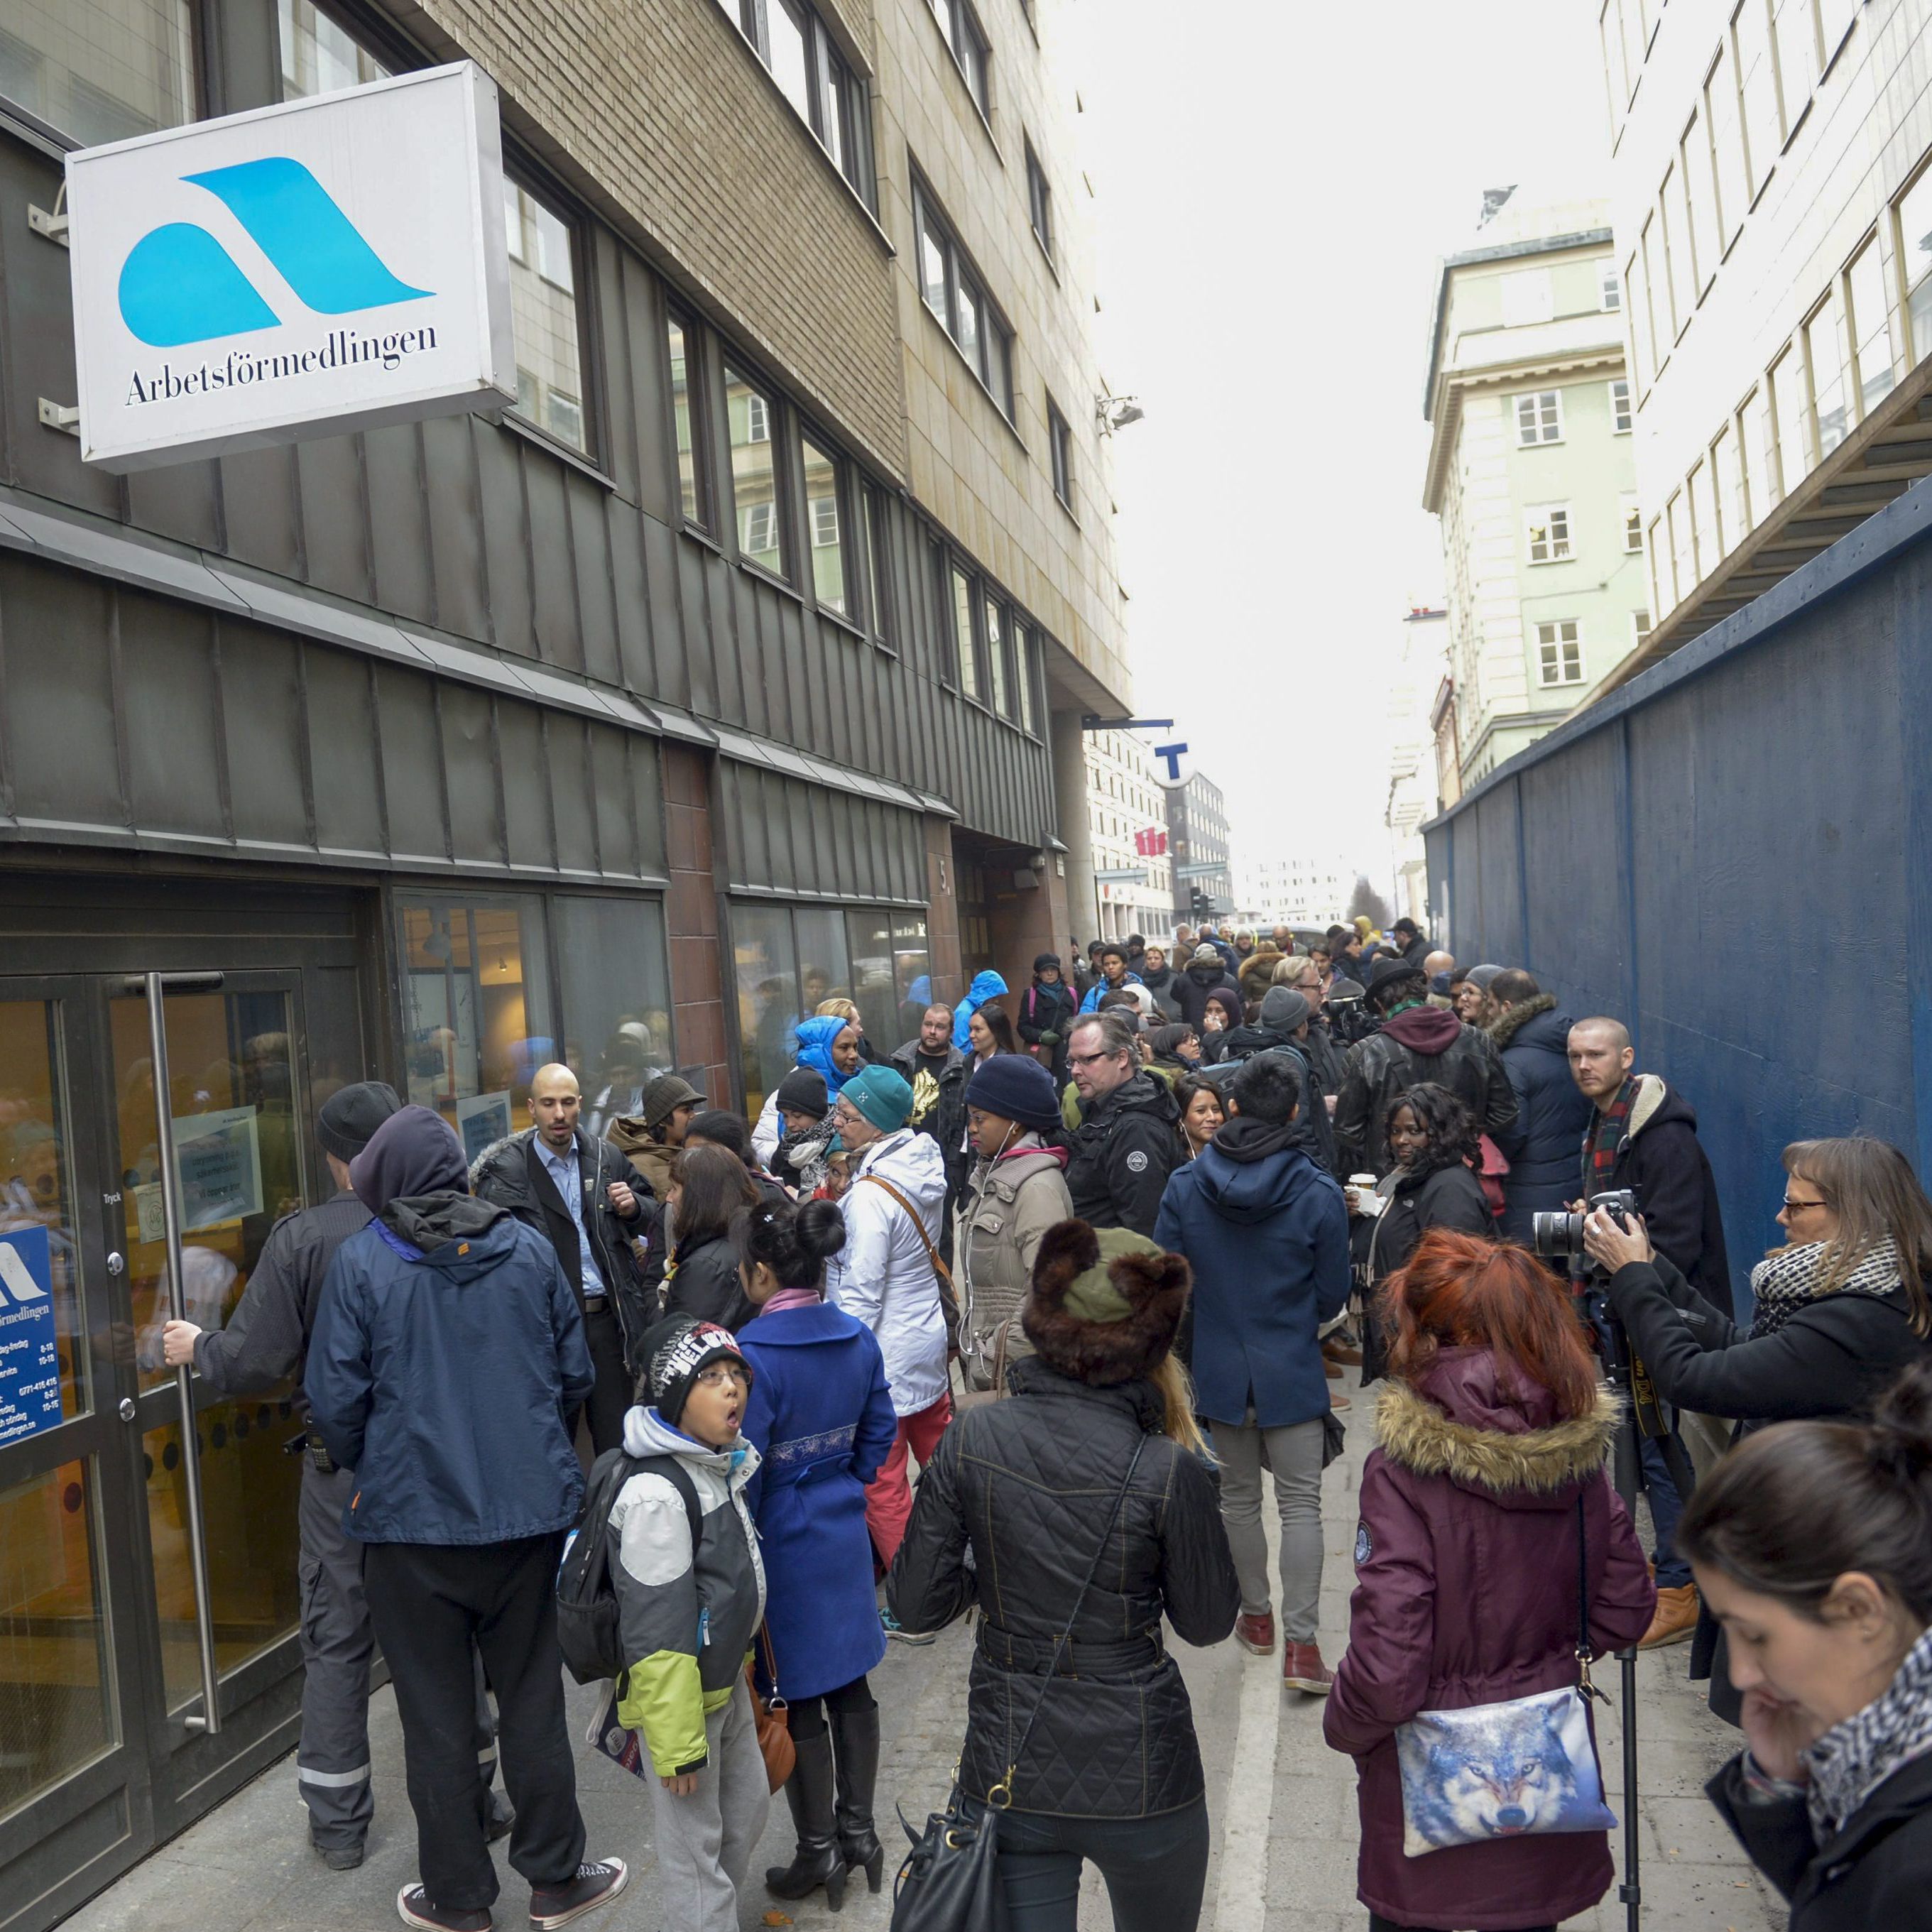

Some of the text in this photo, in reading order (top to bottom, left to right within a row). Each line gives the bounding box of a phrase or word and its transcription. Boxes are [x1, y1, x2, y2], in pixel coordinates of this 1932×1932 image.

[125, 327, 438, 406] Arbetsförmedlingen
[1155, 743, 1188, 780] T
[104, 1192, 121, 1204] Tryck
